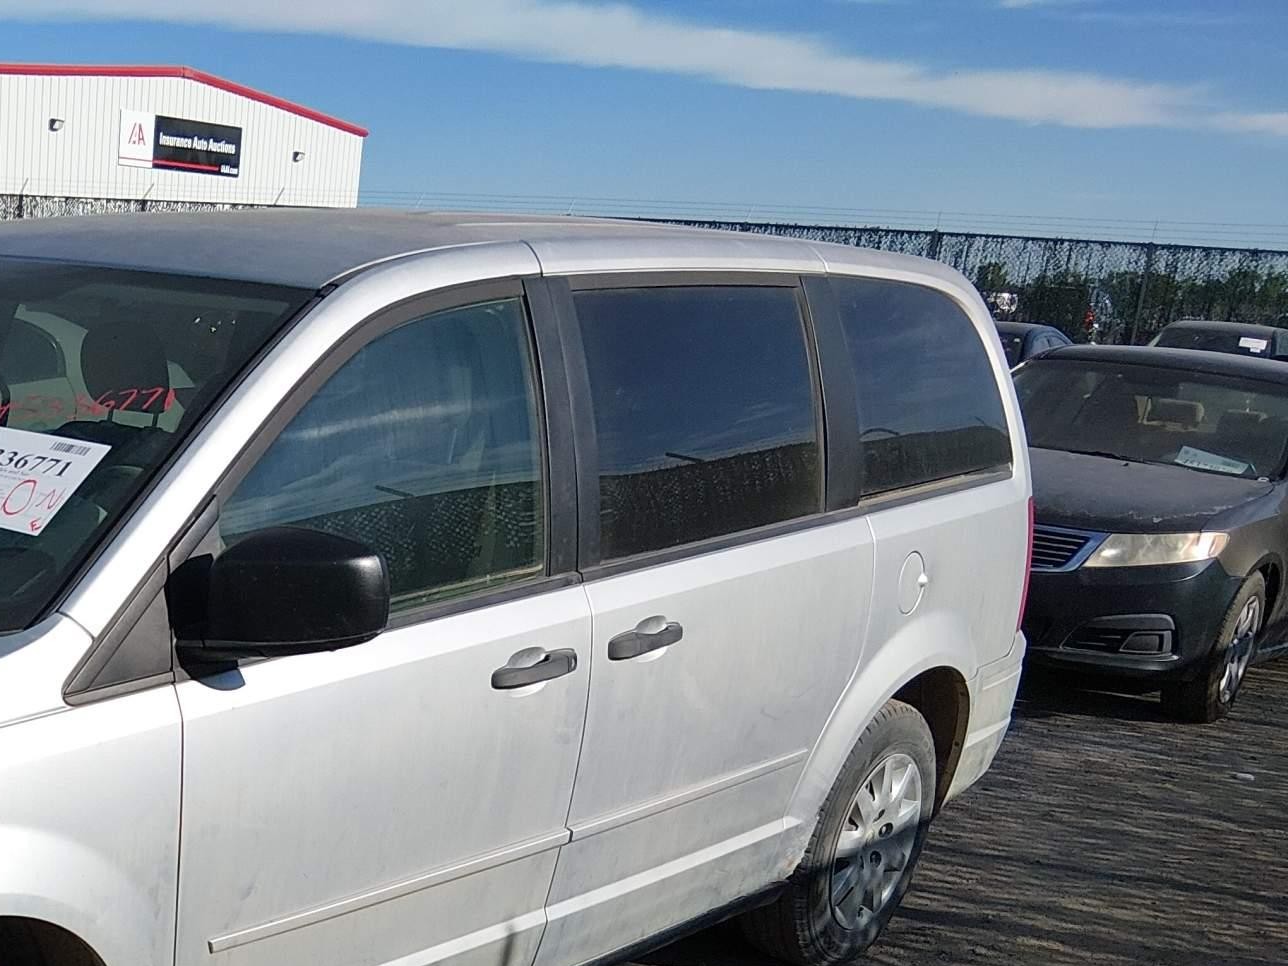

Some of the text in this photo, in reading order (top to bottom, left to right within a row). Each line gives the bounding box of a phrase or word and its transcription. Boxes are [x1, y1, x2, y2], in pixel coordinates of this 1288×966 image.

[159, 131, 236, 155] Insurance Auto Auctions
